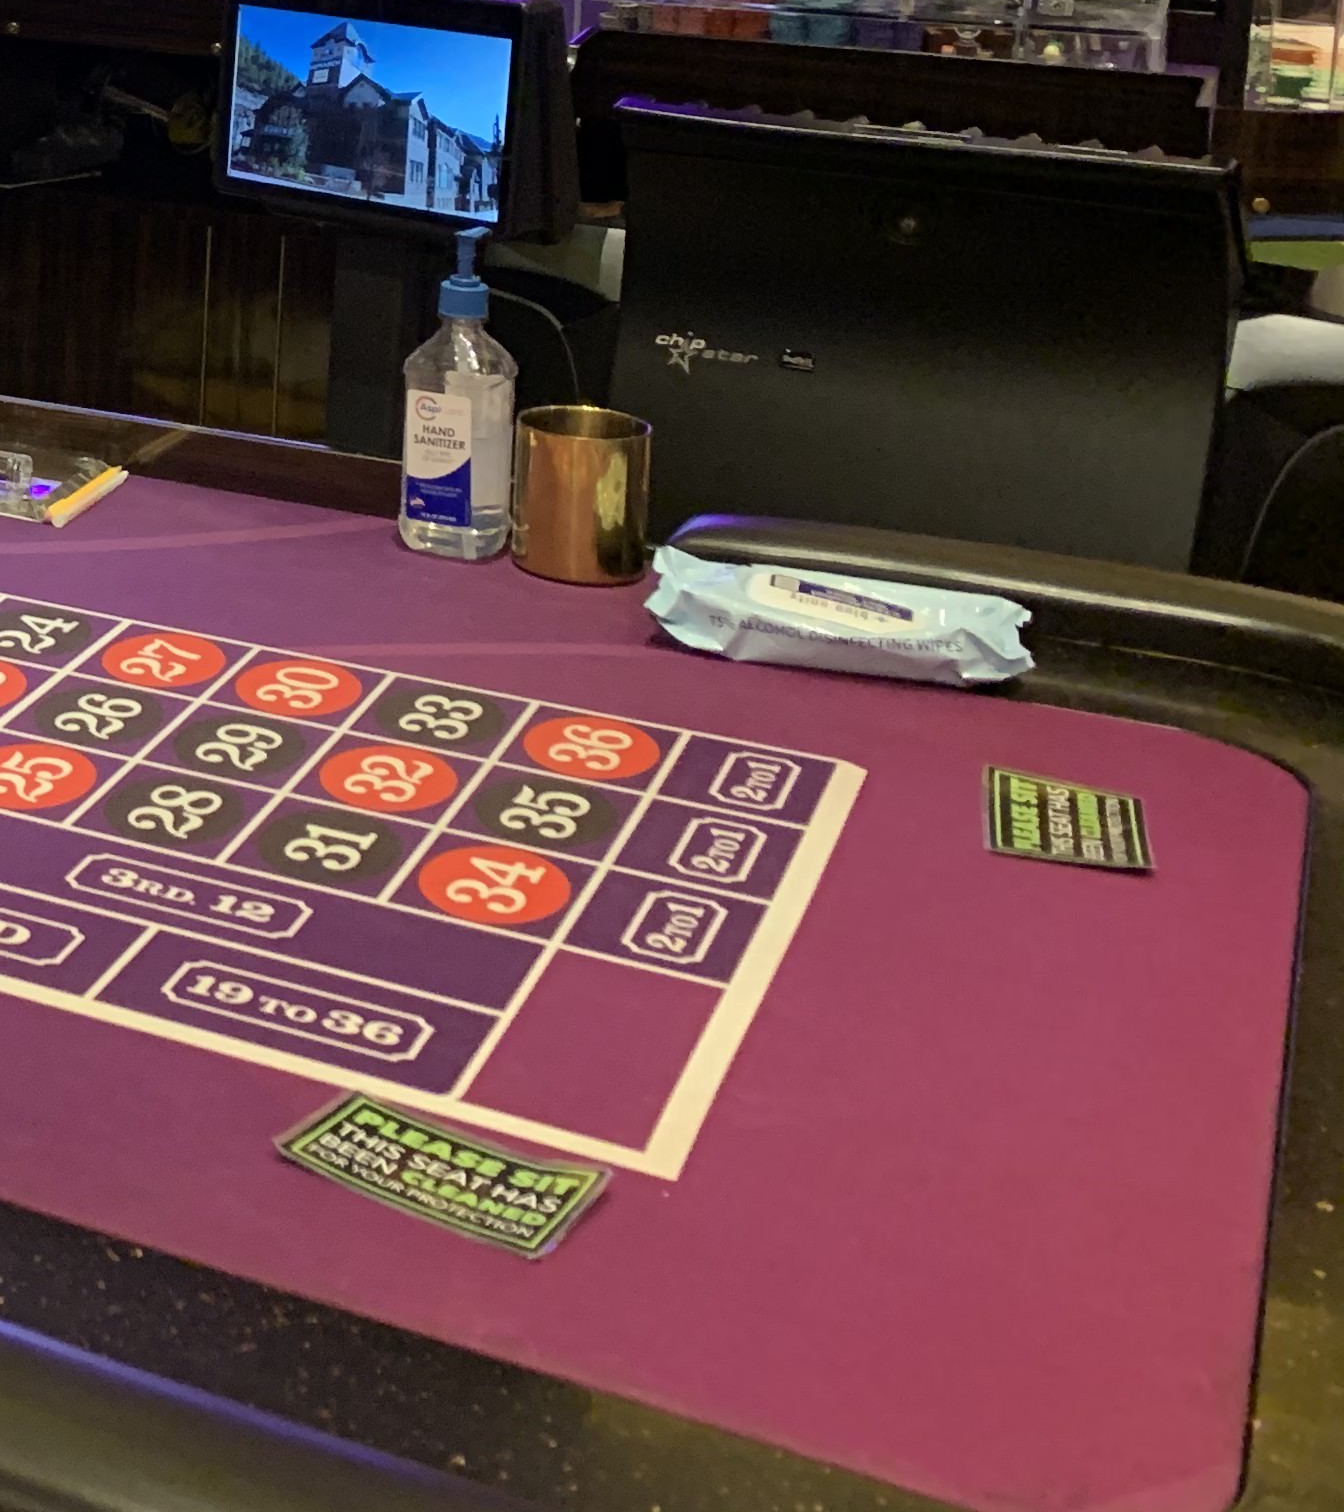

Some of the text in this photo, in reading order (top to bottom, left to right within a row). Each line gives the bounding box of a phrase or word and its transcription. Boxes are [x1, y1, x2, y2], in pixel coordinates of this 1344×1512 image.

[413, 434, 466, 451] SANITIZER
[422, 423, 456, 438] HAND
[121, 639, 200, 681] 27
[257, 668, 338, 708] 30
[55, 694, 141, 739] 26
[399, 695, 482, 739] 33
[196, 724, 282, 770] 29
[549, 725, 631, 769] 36
[345, 756, 433, 801] 32
[128, 786, 222, 838] 28
[500, 786, 589, 838] 35
[285, 825, 377, 870] 31
[210, 891, 275, 922] 12
[447, 858, 545, 912] 34
[187, 974, 253, 1004] 19
[323, 1011, 402, 1044] 36
[338, 1121, 562, 1214] THIS SEAT HAS
[353, 1108, 580, 1197] PLEASE SIT
[318, 1133, 549, 1227] BEEN CLEANED
